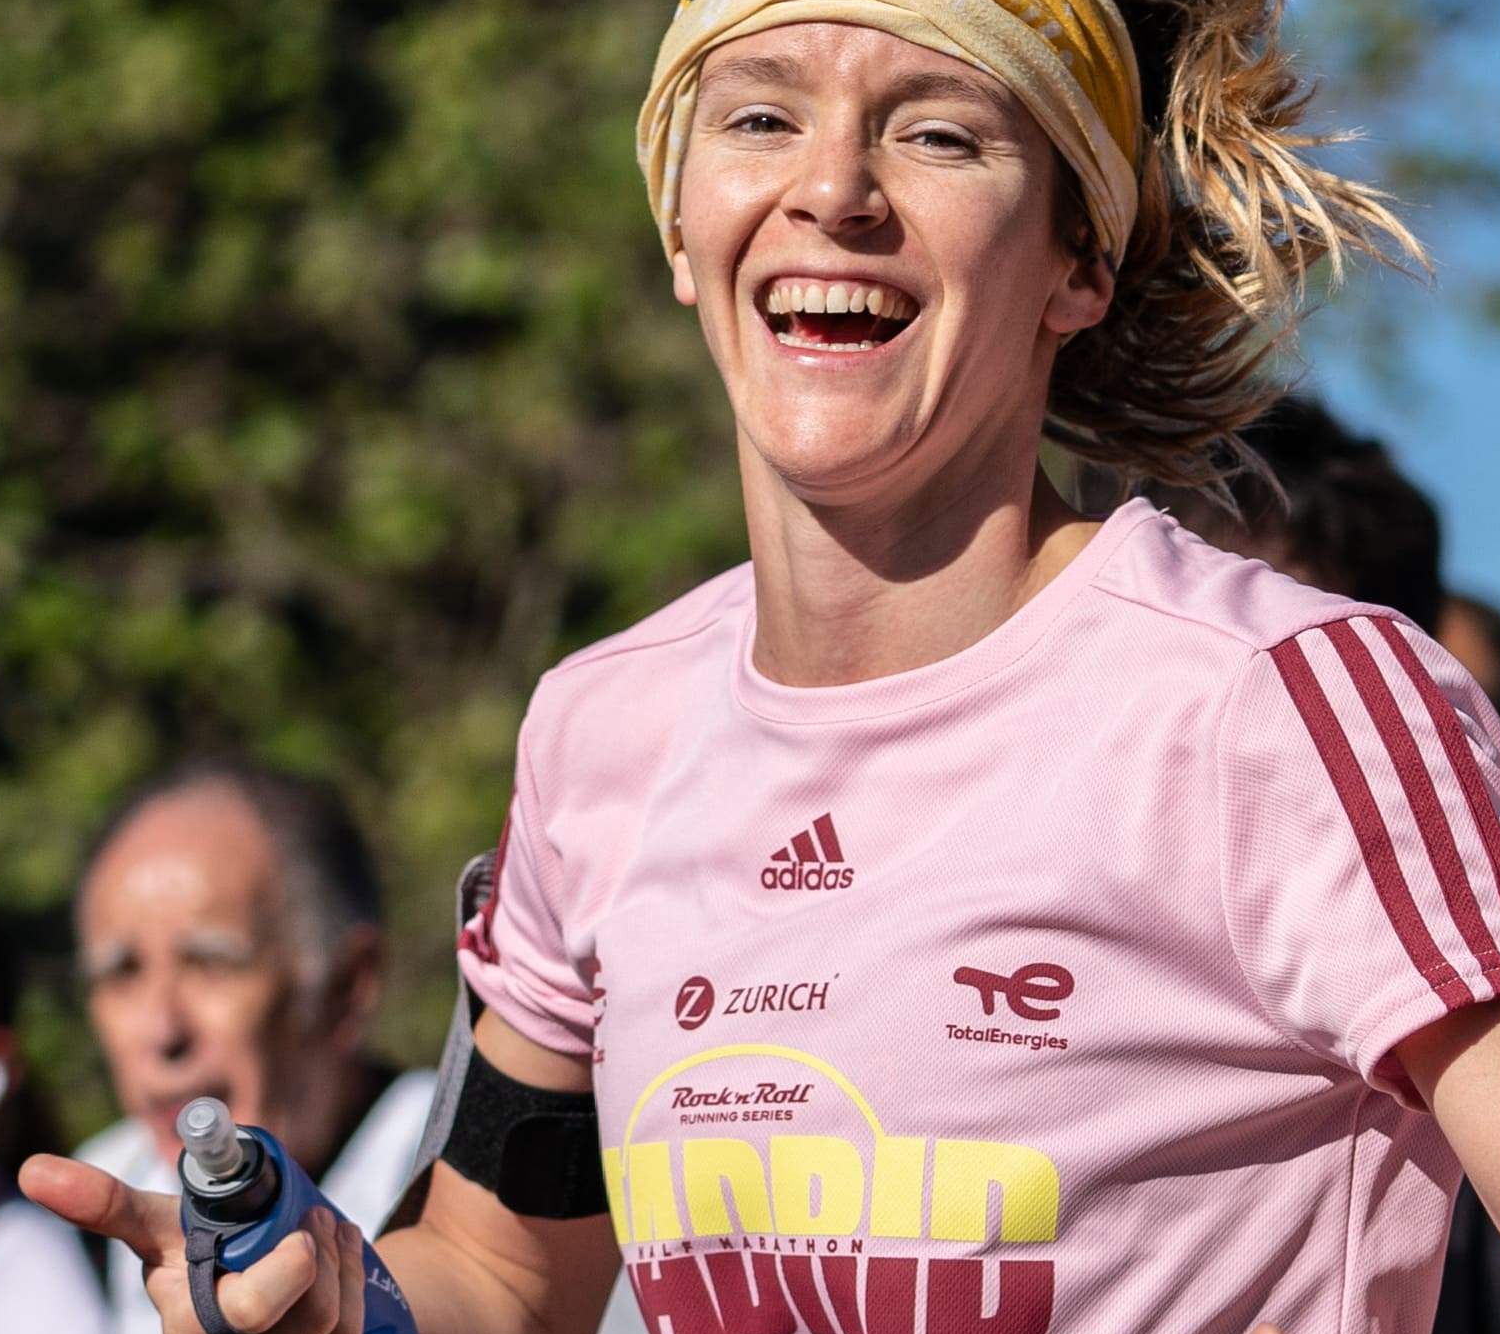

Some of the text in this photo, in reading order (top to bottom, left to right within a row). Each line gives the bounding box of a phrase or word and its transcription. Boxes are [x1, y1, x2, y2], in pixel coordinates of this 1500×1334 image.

[760, 861, 855, 891] adidas
[722, 982, 829, 1015] ZURICH
[945, 1023, 1069, 1051] TotalEnergies
[680, 1110, 793, 1125] RUNNING SERIES
[719, 1237, 863, 1254] MARATHON
